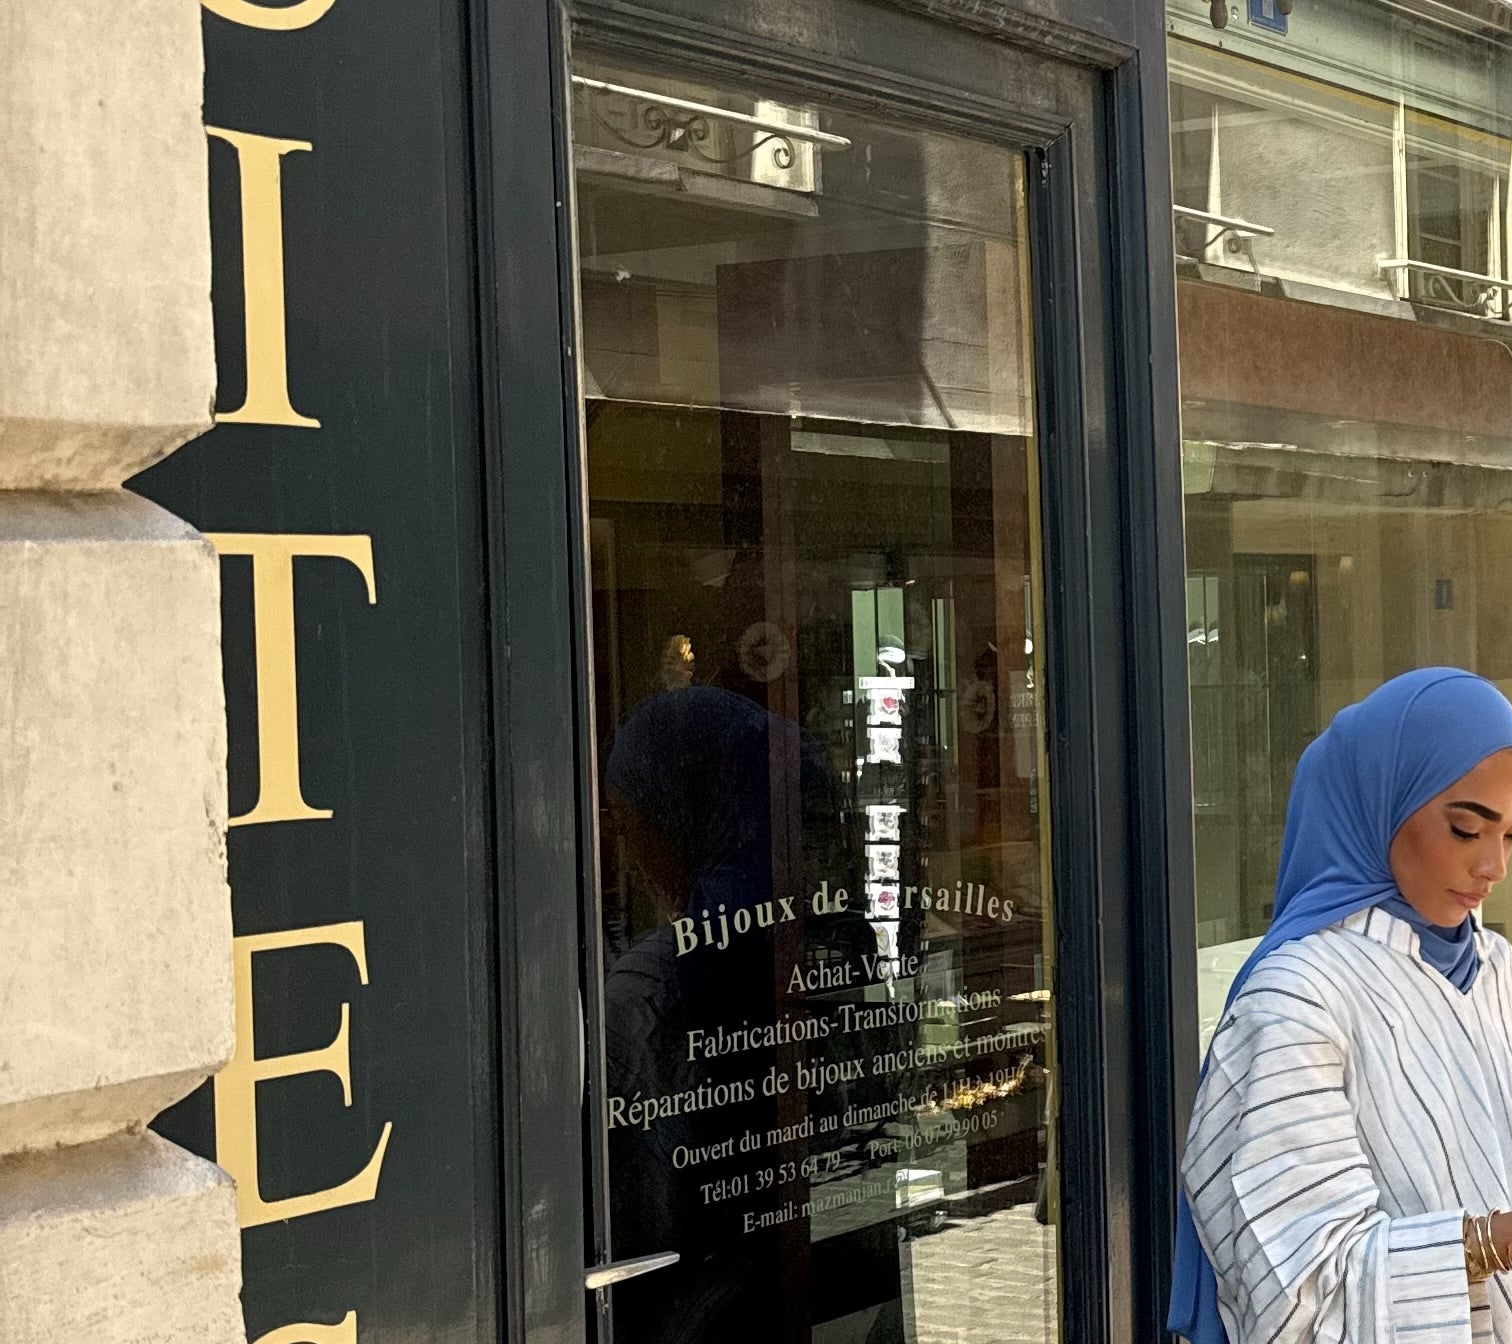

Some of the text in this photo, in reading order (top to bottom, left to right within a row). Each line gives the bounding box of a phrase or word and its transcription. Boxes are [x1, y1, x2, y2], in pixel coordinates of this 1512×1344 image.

[672, 880, 1014, 958] Bijoux de rsailles
[608, 1024, 1047, 1131] Réparations de bijoux anciens et montres
[672, 1136, 734, 1169] Ouvert
[740, 1130, 762, 1152] du
[766, 1114, 815, 1146] mardi
[819, 1115, 838, 1133] au
[842, 1092, 917, 1127] dimanche
[920, 1083, 938, 1106] de
[755, 1167, 774, 1191] 39
[778, 1161, 797, 1185] 53
[801, 1155, 819, 1178] 64
[823, 1150, 841, 1172] 79
[905, 1129, 922, 1150] 06
[982, 1109, 998, 1130] 05
[743, 1200, 798, 1234] E-mail:
